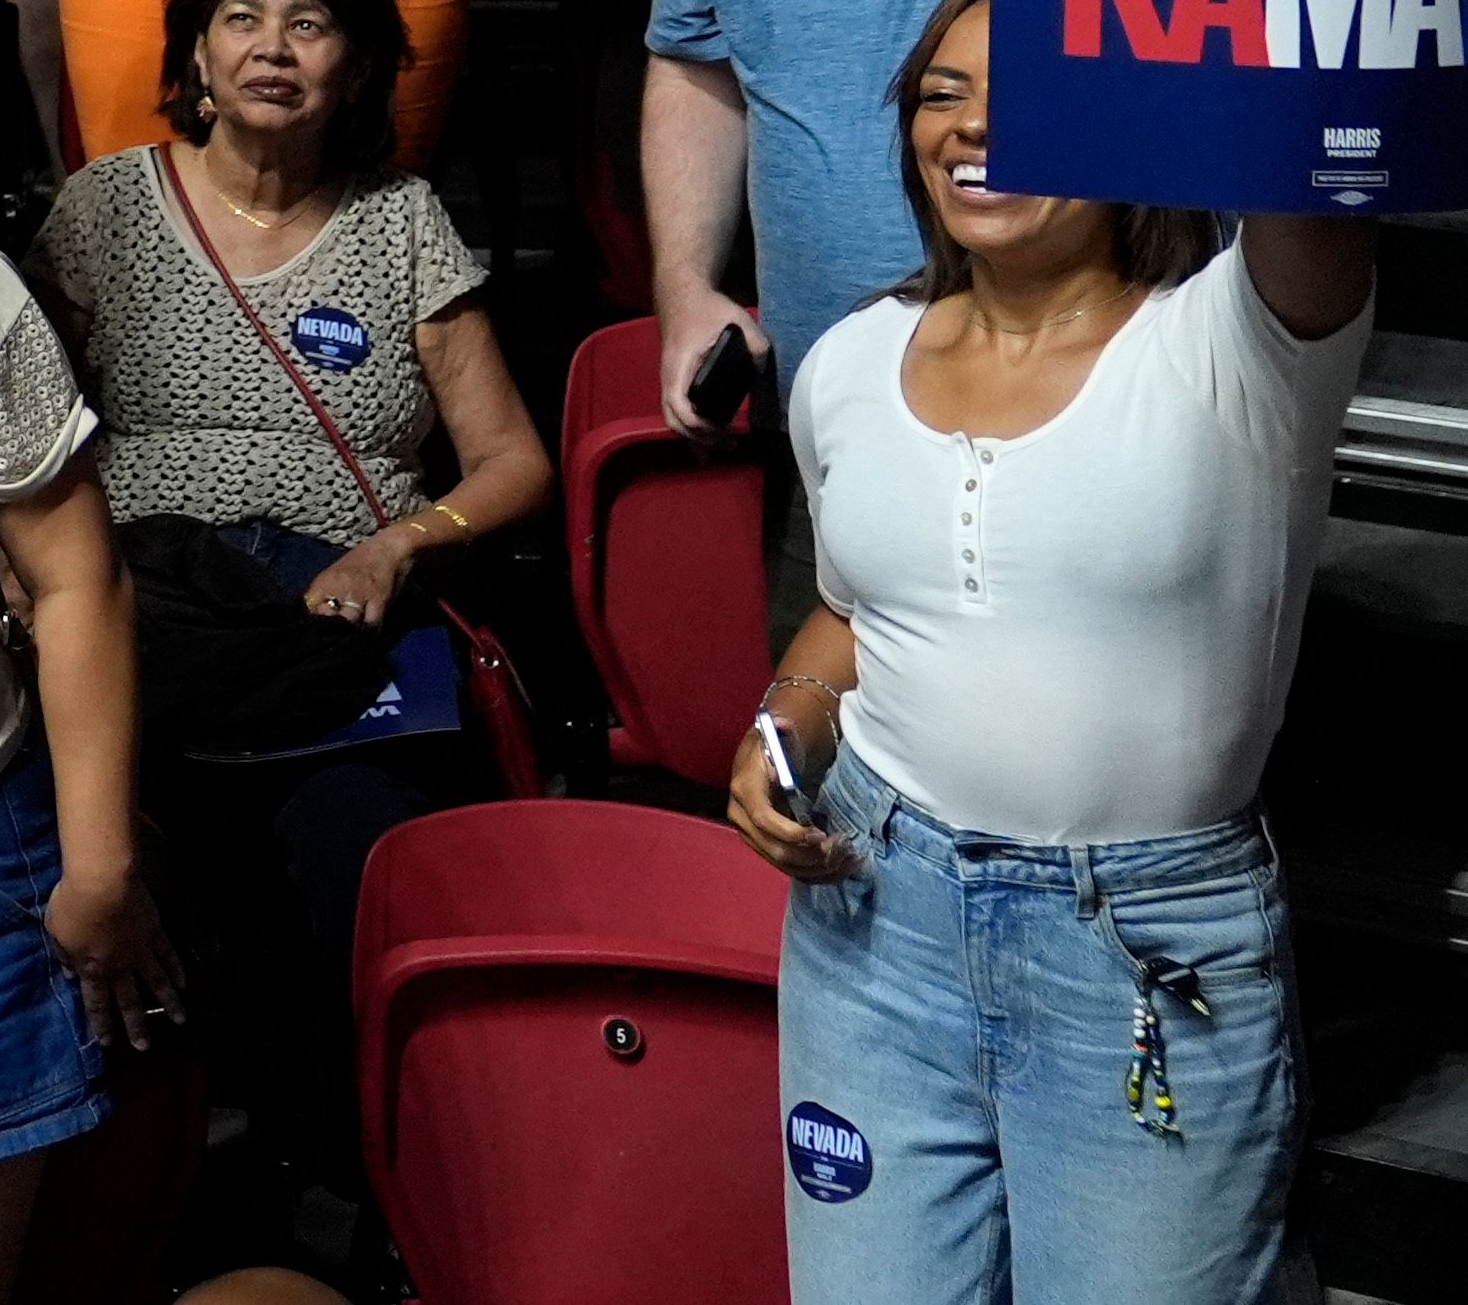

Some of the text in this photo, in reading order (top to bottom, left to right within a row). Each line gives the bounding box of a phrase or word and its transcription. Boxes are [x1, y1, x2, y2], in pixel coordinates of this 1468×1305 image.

[1323, 127, 1382, 149] HARRIS
[298, 316, 364, 347] NEVADA
[616, 1027, 627, 1044] 5
[791, 1115, 864, 1164] NEVADA
